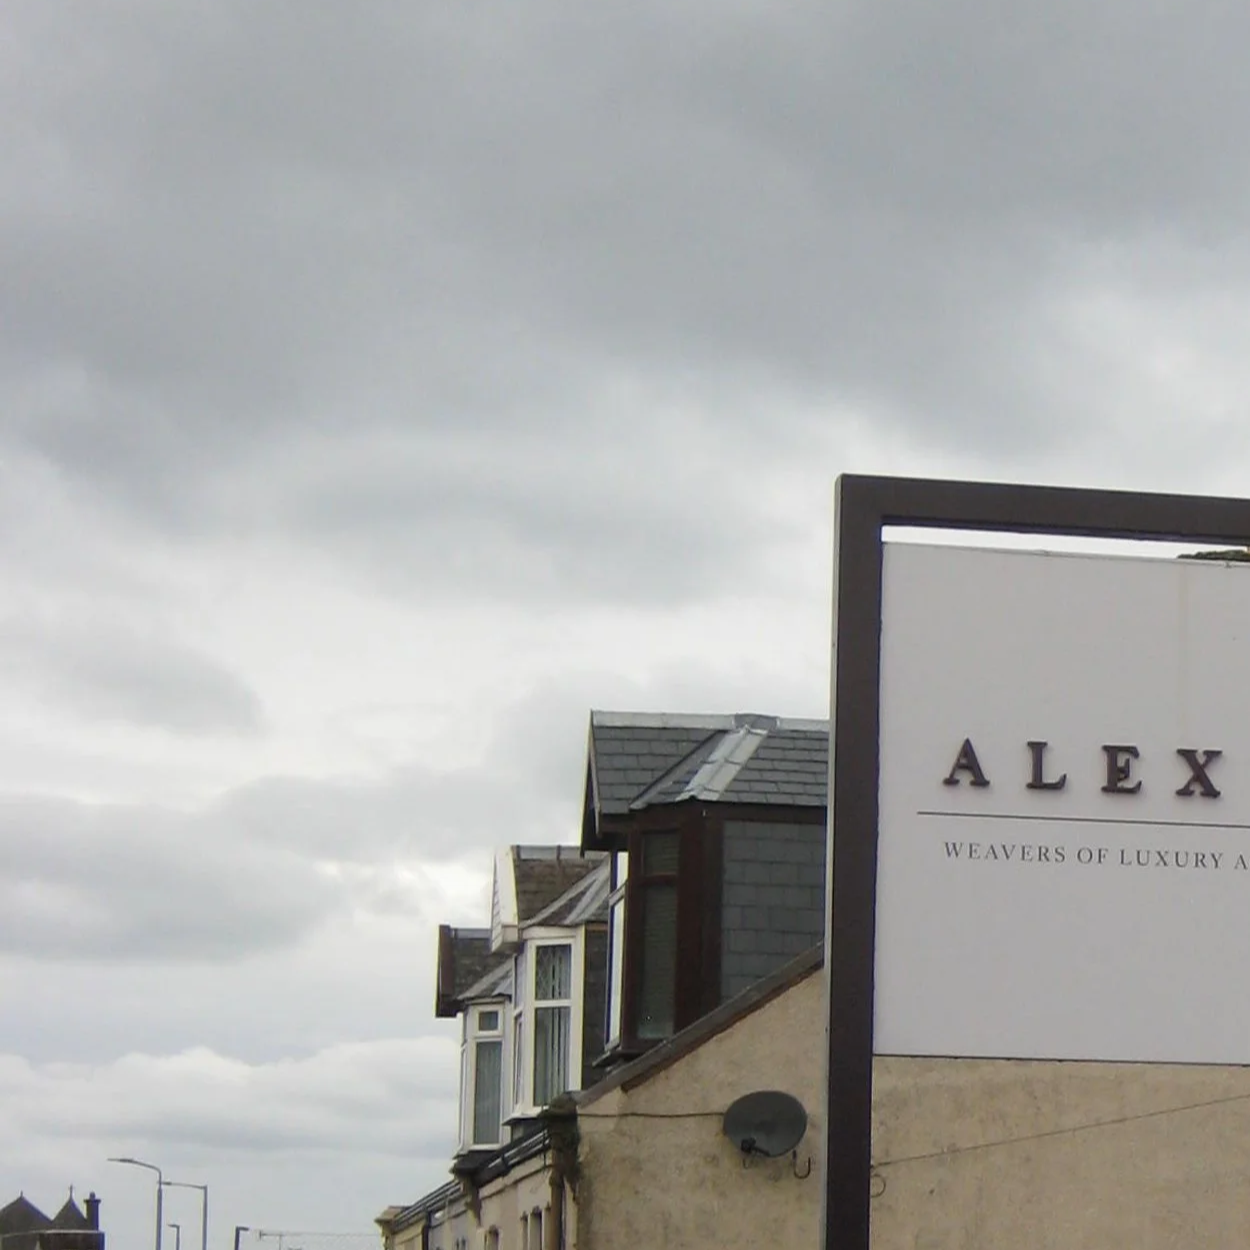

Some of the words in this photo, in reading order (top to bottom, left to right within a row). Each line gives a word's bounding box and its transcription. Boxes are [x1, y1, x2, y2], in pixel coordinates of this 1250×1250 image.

[943, 738, 1224, 798] ALEX
[943, 841, 1066, 863] WEAVERS
[1076, 847, 1108, 864] OF
[1119, 849, 1223, 870] LUXURY
